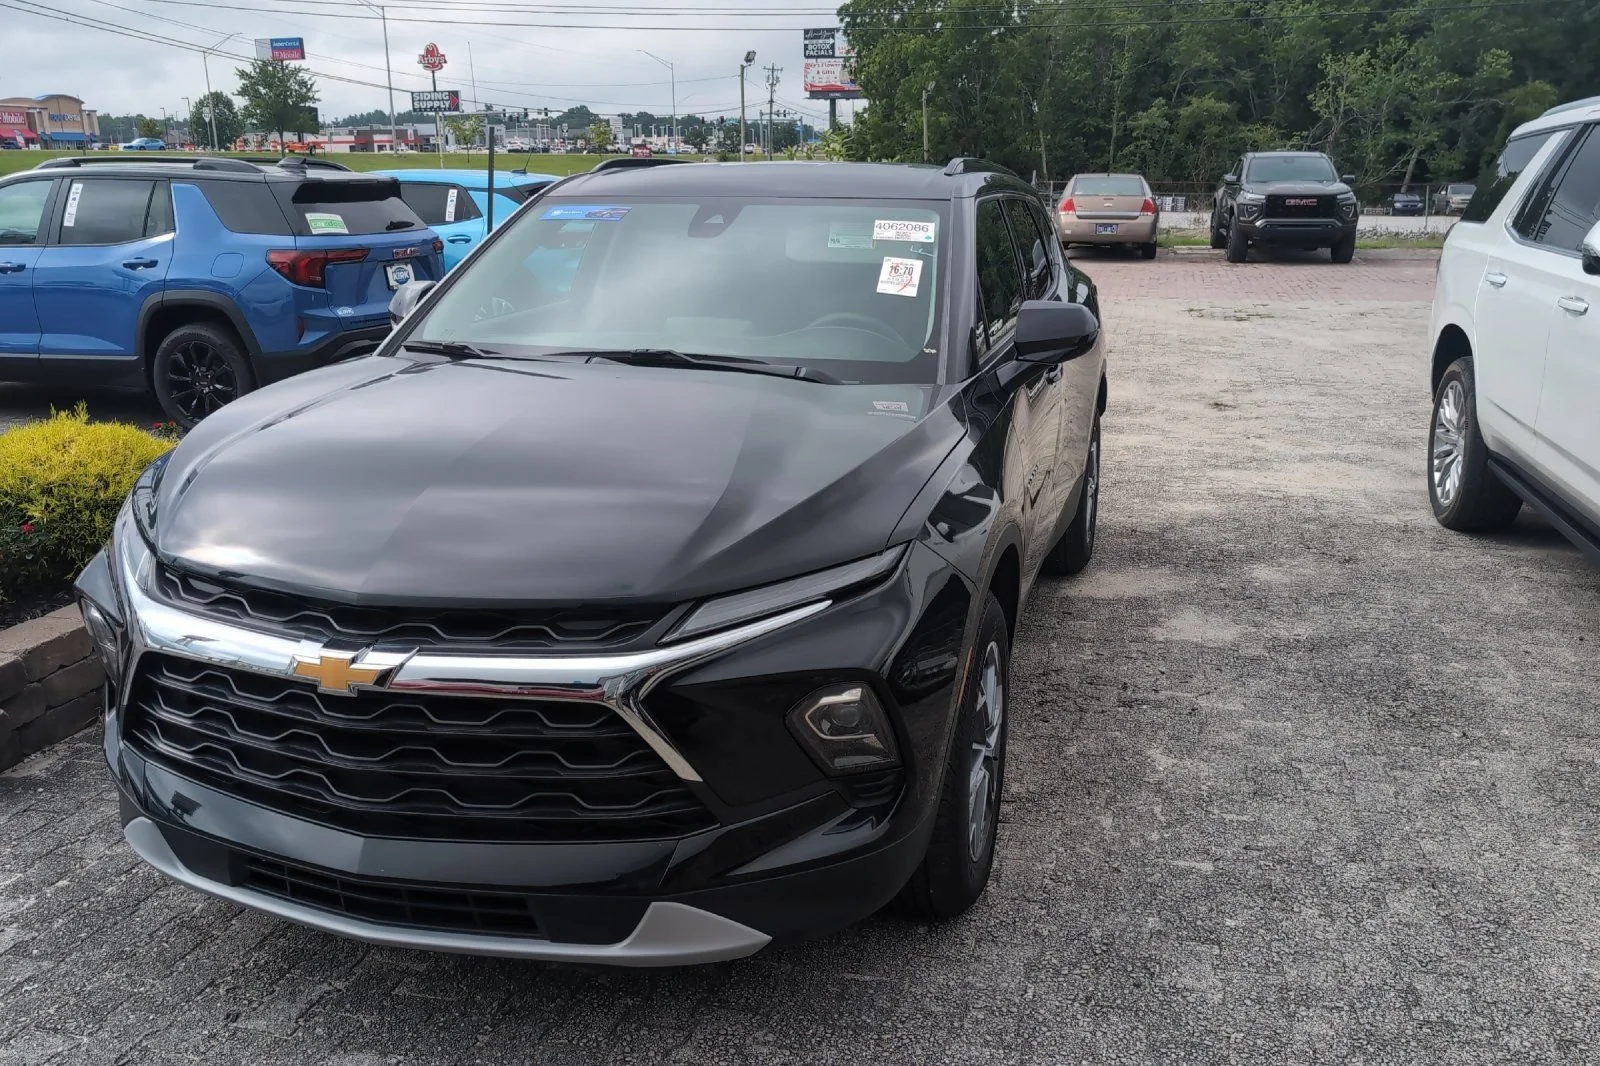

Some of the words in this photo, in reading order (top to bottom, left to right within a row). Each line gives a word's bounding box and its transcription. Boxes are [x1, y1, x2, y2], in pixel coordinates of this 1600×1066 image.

[413, 92, 449, 100] SIDING
[413, 100, 450, 109] SUPPLY
[875, 223, 929, 232] 4062086
[392, 270, 410, 280] KIRK
